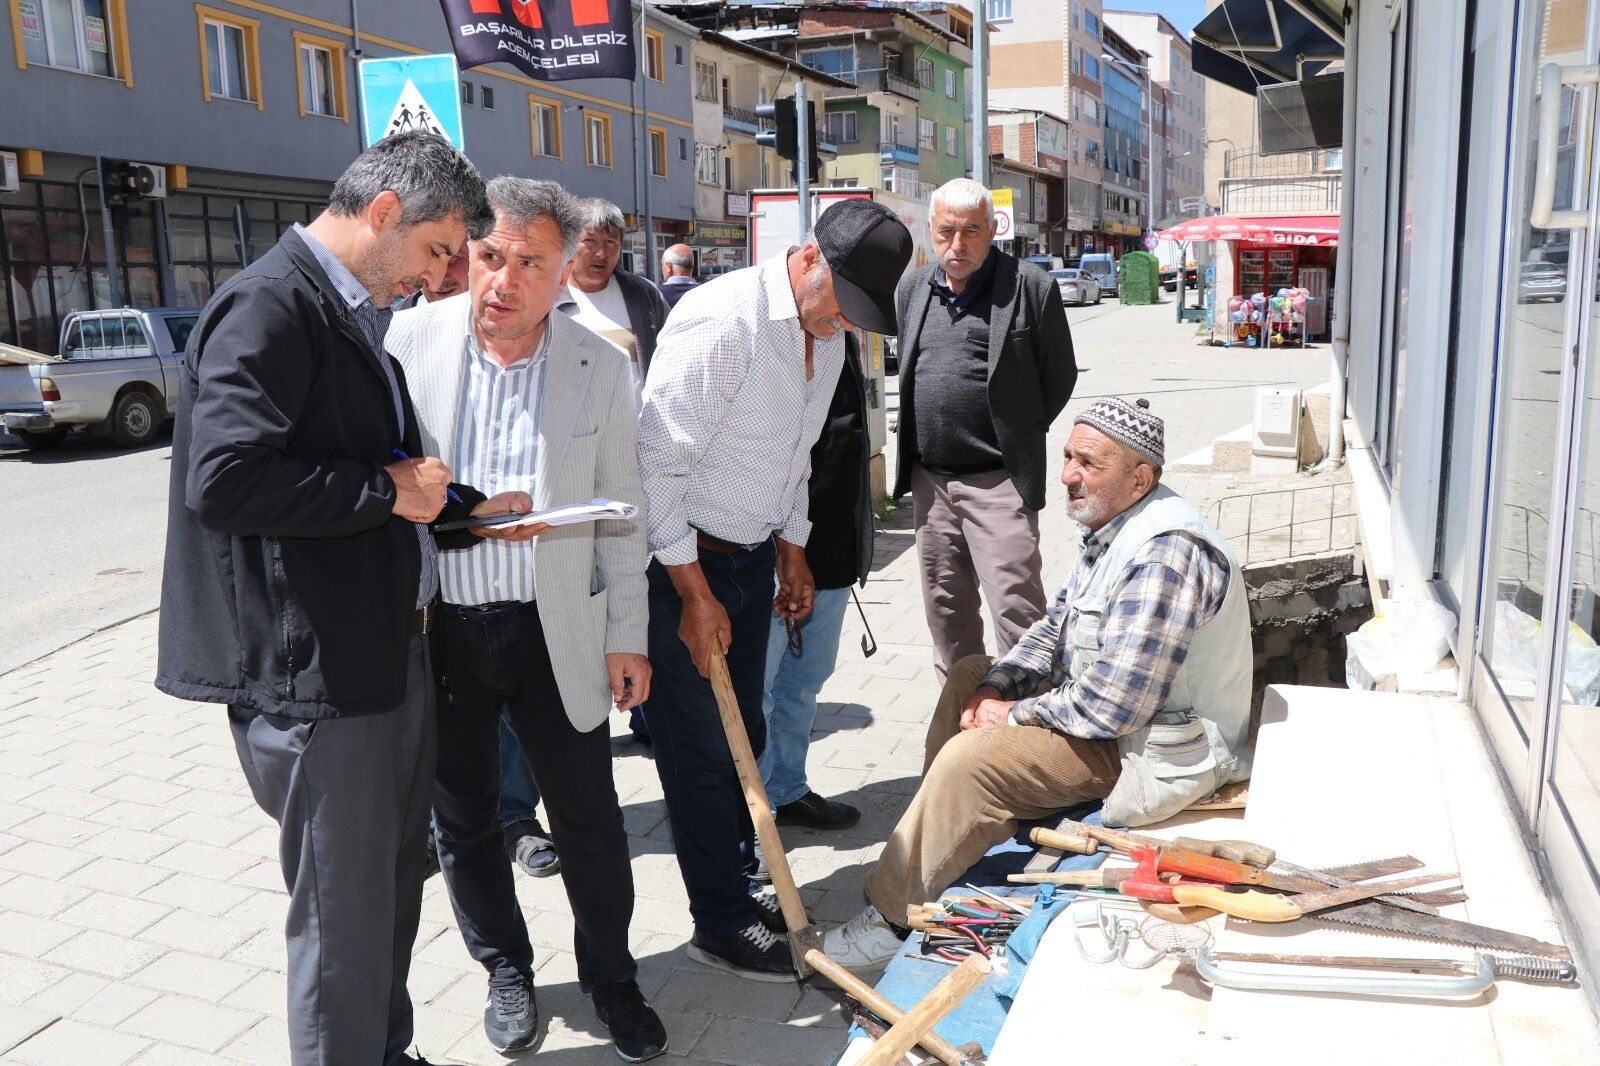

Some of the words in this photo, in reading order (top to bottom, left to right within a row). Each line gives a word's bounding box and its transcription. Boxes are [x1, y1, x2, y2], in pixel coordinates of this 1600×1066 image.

[460, 22, 545, 50] BAŞARILAR
[551, 31, 628, 50] DİLERİZ
[497, 39, 531, 63] ADEM
[531, 50, 600, 69] ÇELEBİ
[1272, 233, 1318, 244] GIDA
